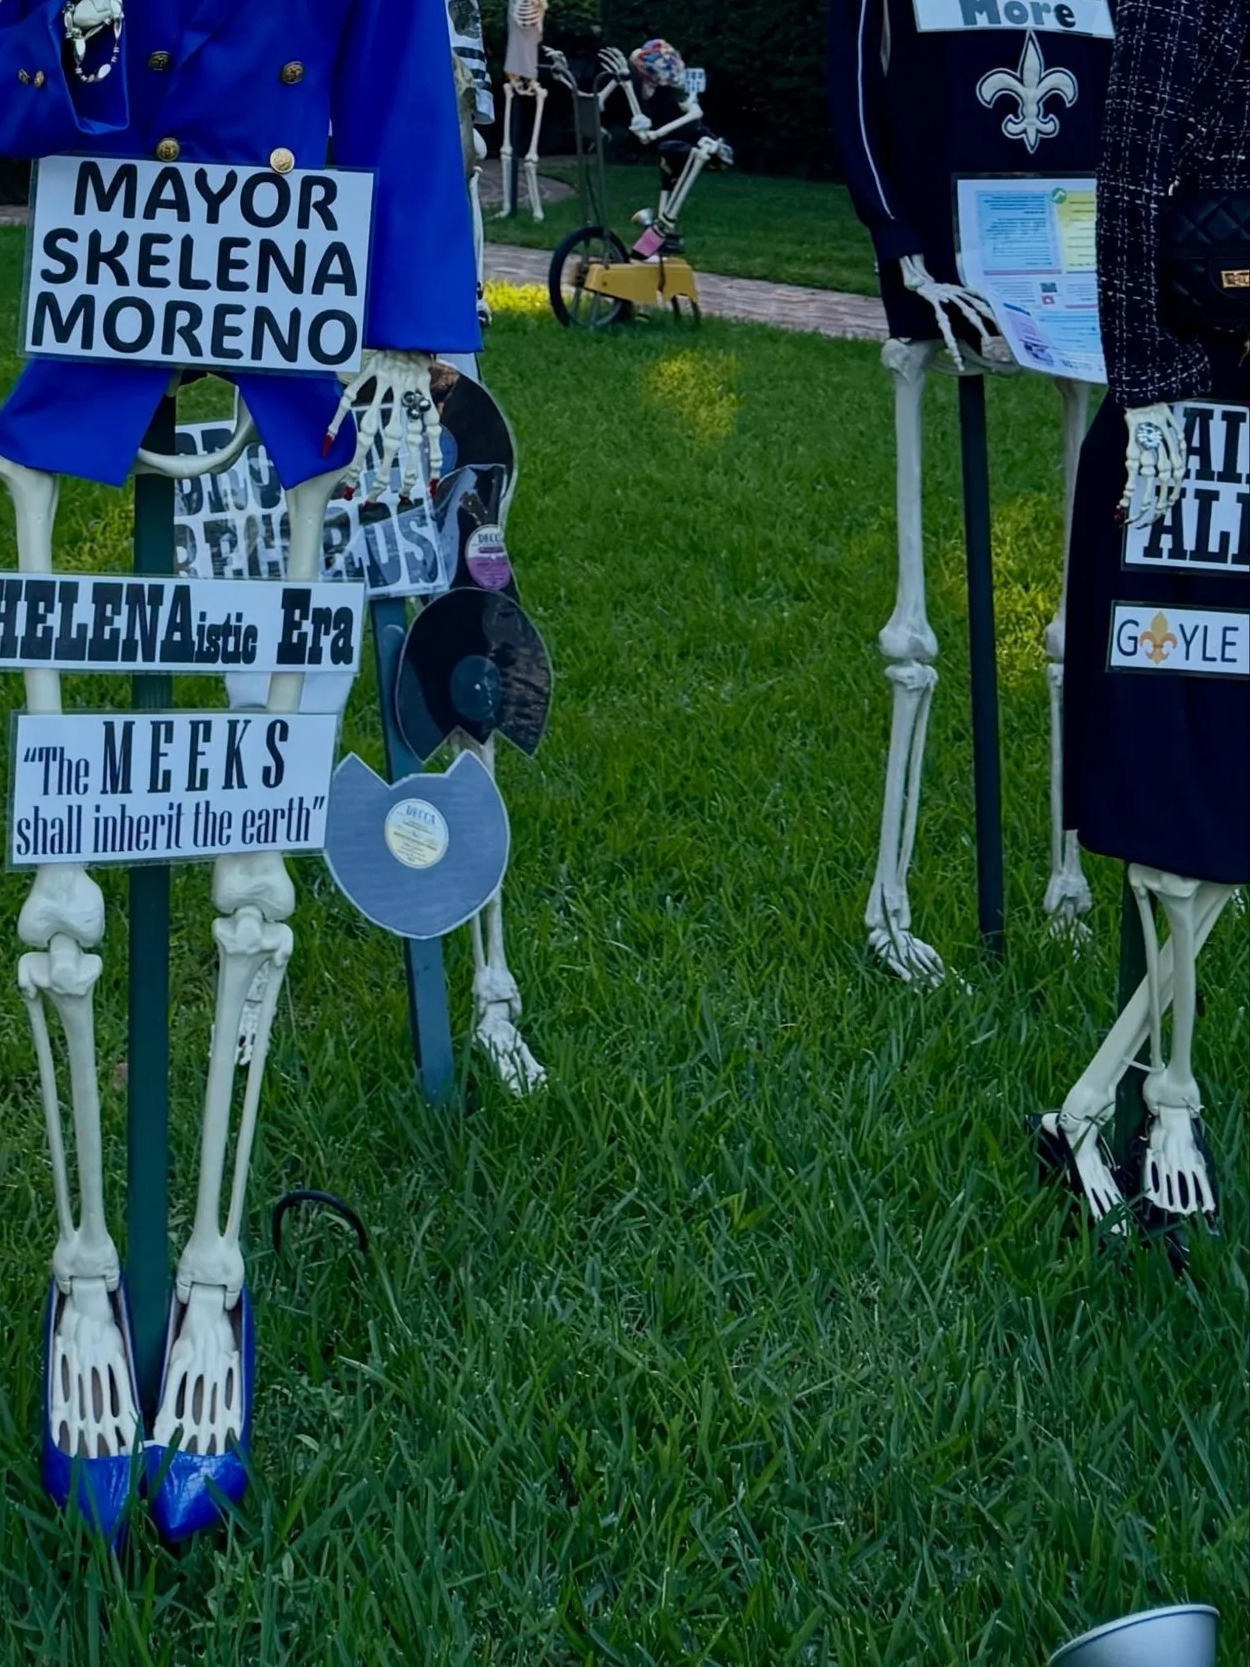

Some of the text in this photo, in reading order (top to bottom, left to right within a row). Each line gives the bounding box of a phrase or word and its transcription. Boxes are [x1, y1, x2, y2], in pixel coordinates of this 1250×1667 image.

[74, 161, 338, 231] MAYOR
[40, 228, 358, 296] SKELENA
[31, 291, 358, 365] MORENO
[277, 588, 354, 665] Era
[23, 719, 289, 796] "The MEEKS
[16, 795, 326, 855] shall inherit the earth"
